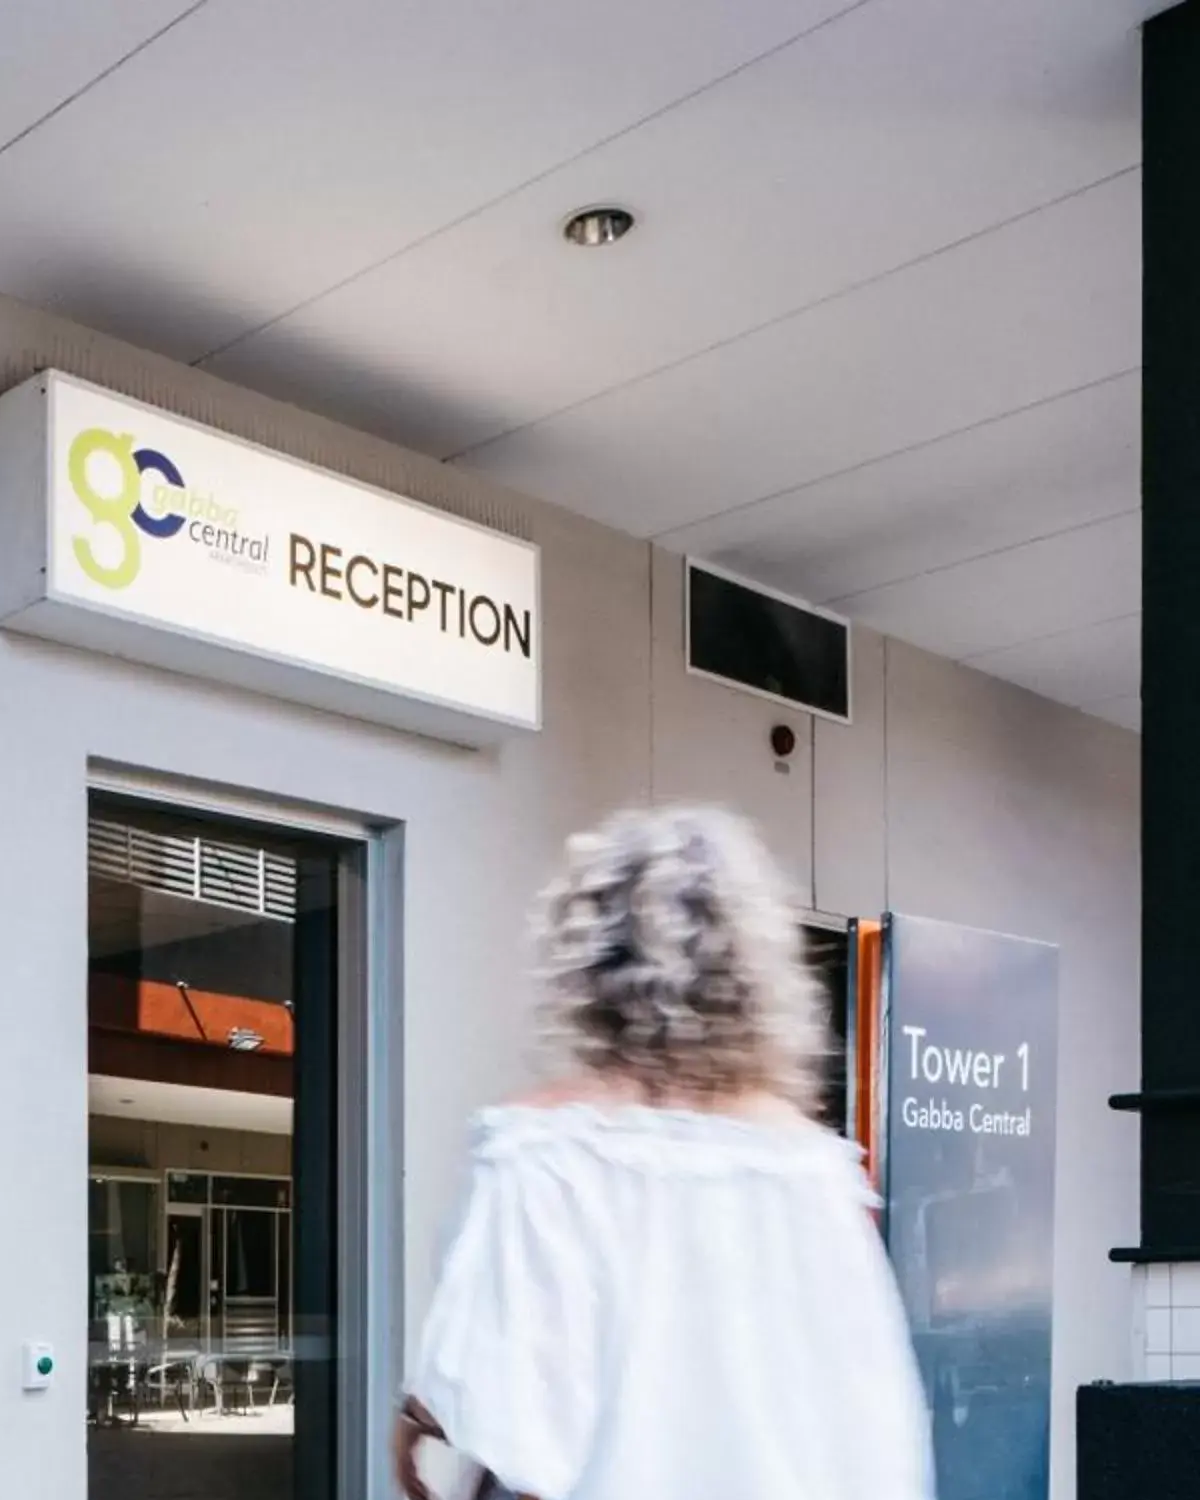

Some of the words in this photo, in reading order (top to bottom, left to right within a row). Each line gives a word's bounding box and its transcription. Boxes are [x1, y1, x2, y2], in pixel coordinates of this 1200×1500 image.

[188, 520, 269, 561] central
[289, 532, 531, 659] RECEPTION
[902, 1024, 1005, 1089] Tower
[1017, 1041, 1029, 1091] 1
[902, 1096, 964, 1132] Gabba
[969, 1103, 1031, 1136] Central
